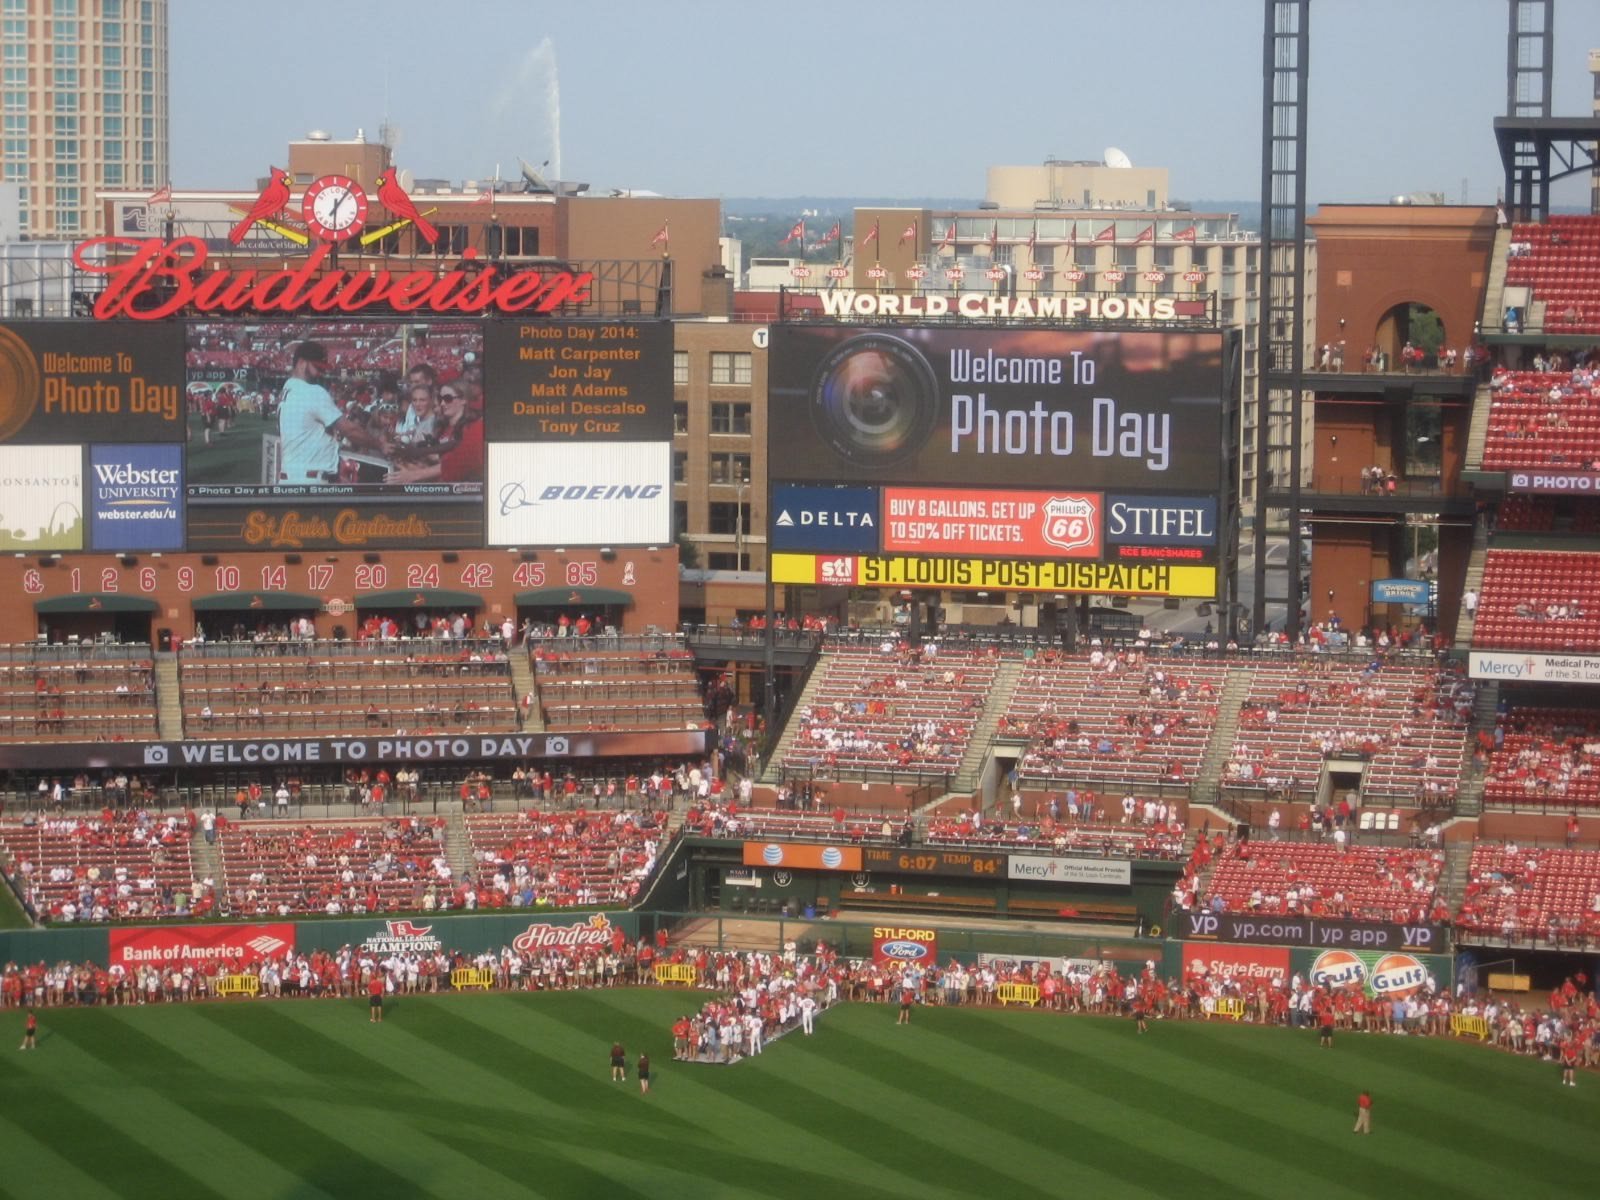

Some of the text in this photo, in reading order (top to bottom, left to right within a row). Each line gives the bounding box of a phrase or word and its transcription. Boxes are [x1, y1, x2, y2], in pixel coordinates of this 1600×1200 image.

[73, 236, 595, 320] Budweiser
[792, 269, 809, 277] 1926
[868, 270, 886, 278] 1934
[906, 270, 924, 278] 1942
[985, 271, 1004, 279] 1946
[1024, 271, 1043, 279] 1964
[1065, 271, 1082, 279] 1967
[1103, 272, 1122, 280] 1982
[1144, 273, 1164, 281] 2006
[1185, 273, 1202, 281] 2011
[820, 290, 1175, 319] WORLD CHAMPIONS
[520, 326, 639, 341] Photo Day 2014:
[757, 332, 766, 345] T
[43, 353, 132, 374] Welcome To
[519, 346, 641, 363] Matt Carpenter
[549, 365, 611, 380] Jon Jay
[950, 348, 1061, 385] Welcome
[1070, 351, 1095, 385] To
[44, 377, 177, 421] Photo Day
[531, 383, 628, 397] Matt Adams
[513, 401, 646, 415] Daniel Descalso
[540, 419, 621, 435] Tony Cruz
[951, 393, 1170, 470] Photo Day
[0, 477, 70, 486] ONSANTO
[94, 463, 178, 485] Webster
[1533, 475, 1591, 489] PHOTO
[98, 487, 179, 499] UNIVERSITY
[198, 486, 231, 494] Photo
[234, 486, 255, 495] Day
[273, 486, 306, 495] Busch
[309, 486, 353, 494] Stadium
[403, 485, 450, 493] Welcome
[539, 484, 662, 500] BOEING
[98, 508, 177, 520] webster.edu/u
[890, 499, 1036, 520] BUY 8 GALLONS. GET UP
[1050, 504, 1088, 516] PHILLIPS
[332, 508, 428, 544] Cardinals
[801, 511, 874, 528] DELTA
[1051, 518, 1083, 538] 66
[1110, 502, 1213, 537] STIFEL
[271, 511, 331, 547] Louis
[890, 521, 1024, 542] TO 50% OFF TICKETS.
[1140, 548, 1203, 559] BANCSHARES
[407, 564, 440, 588] 24
[461, 563, 493, 588] 42
[513, 562, 545, 587] 45
[566, 562, 597, 586] 85
[821, 557, 853, 577] stl
[865, 557, 1171, 593] ST. LOUIS POST-DISPATCH
[71, 568, 81, 592] 1
[102, 568, 118, 592] 2
[140, 568, 156, 592] 6
[178, 567, 194, 592] 9
[216, 566, 240, 591] 10
[262, 566, 287, 591] 14
[308, 565, 334, 590] 17
[355, 564, 387, 589] 20
[1479, 660, 1523, 678] Mercy
[1545, 658, 1582, 668] Medical
[182, 737, 533, 764] WELCOME TO PHOTO DAY
[867, 850, 892, 860] TIME
[899, 855, 937, 870] 6:07
[943, 854, 971, 864] TEMP
[1015, 863, 1049, 878] Mercy
[874, 927, 935, 941] STLFORD
[1189, 915, 1218, 935] yp
[1233, 923, 1303, 939] yp.com
[366, 936, 404, 944] NATIONAL
[1321, 926, 1388, 947] yp app
[1402, 926, 1431, 946] yp
[123, 944, 243, 960] Bank of America
[890, 943, 917, 957] Ford
[1373, 968, 1422, 990] Gulf
